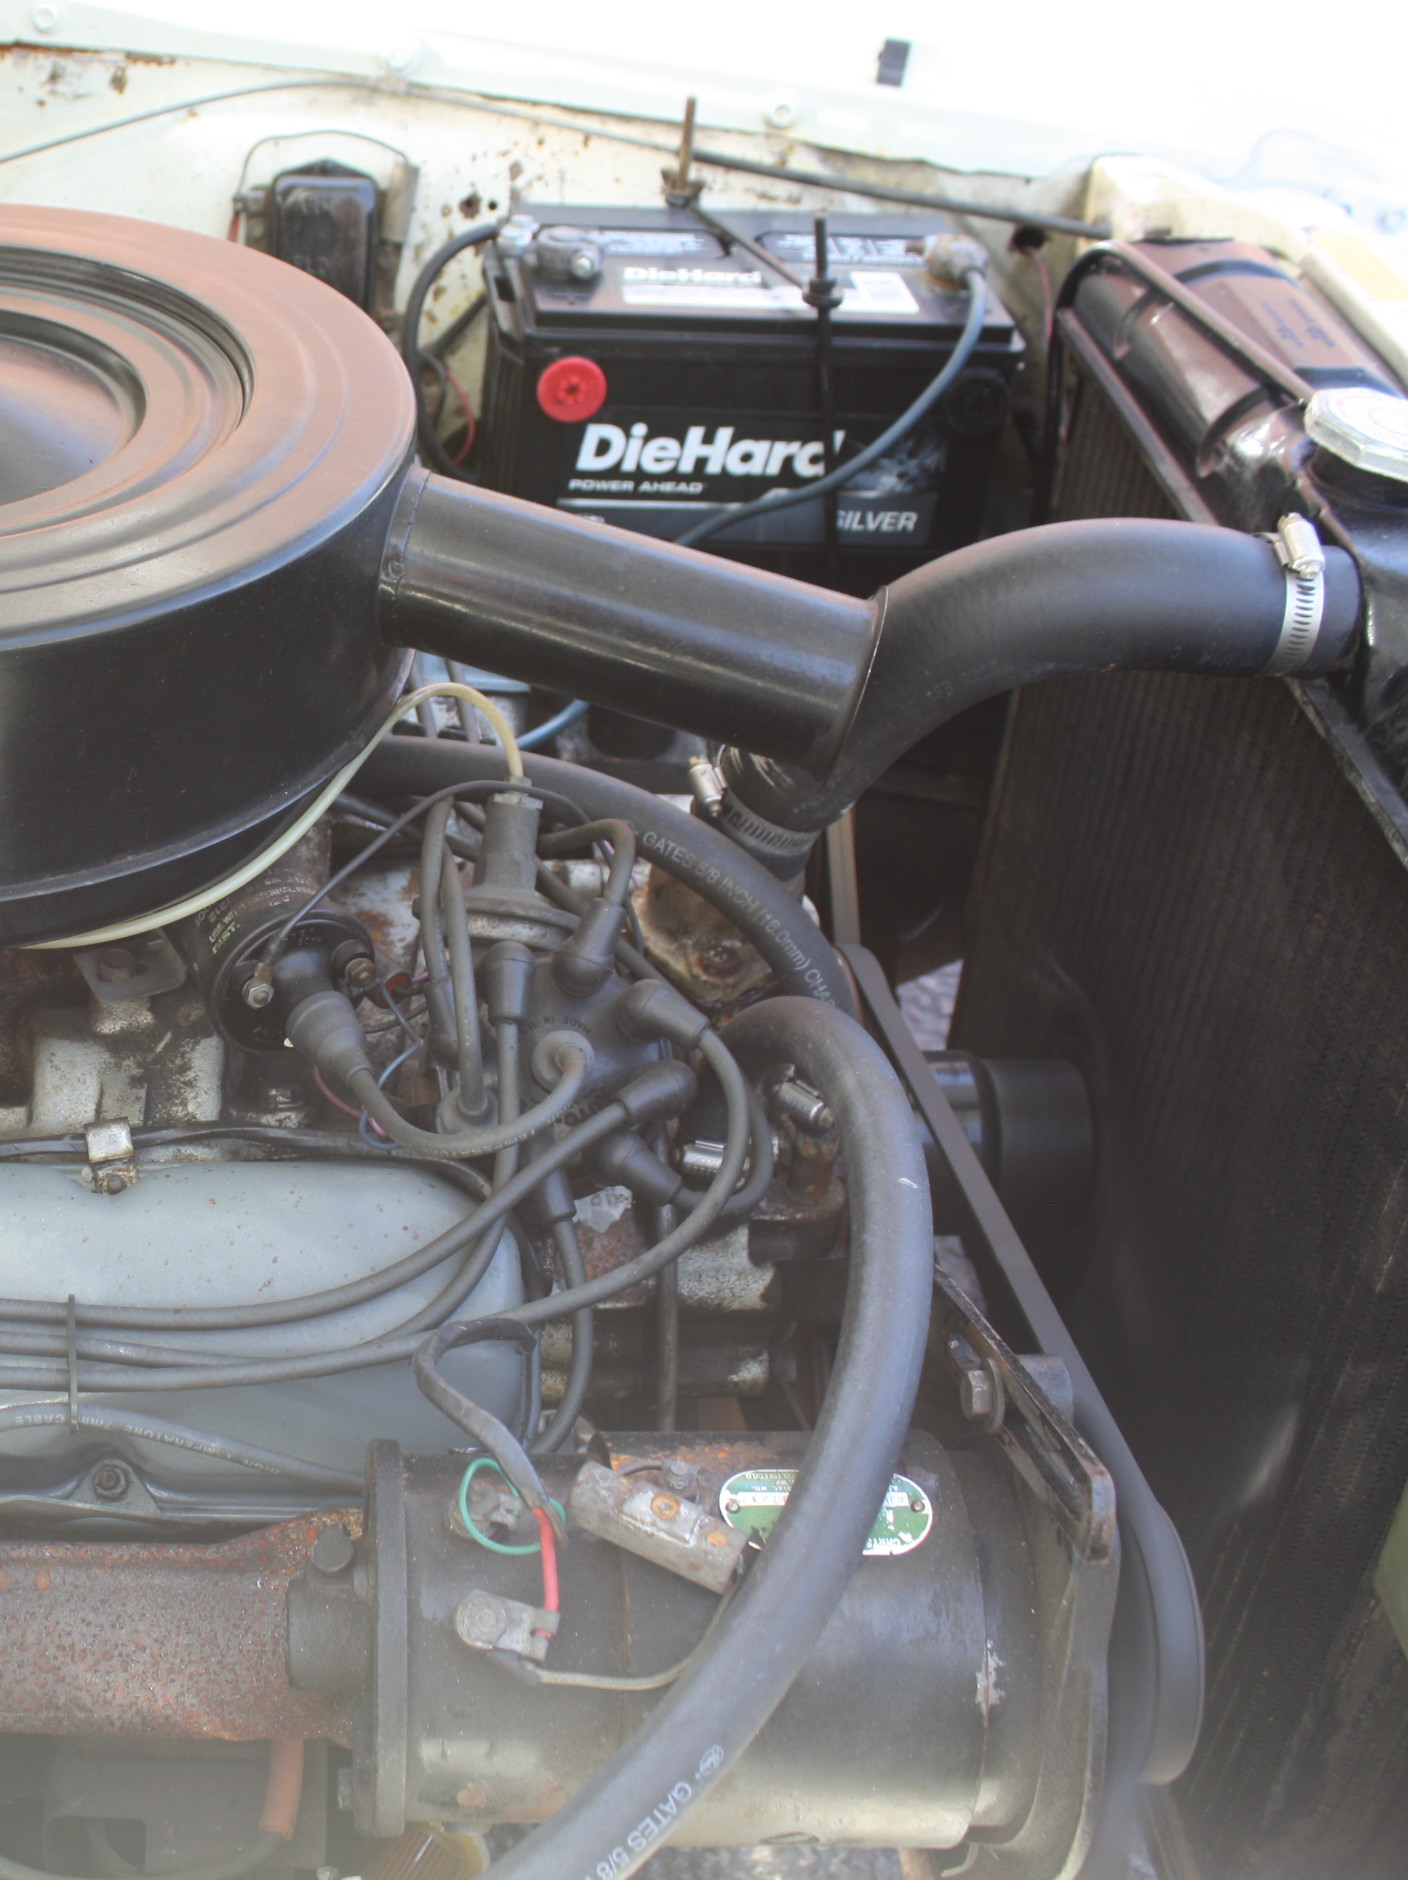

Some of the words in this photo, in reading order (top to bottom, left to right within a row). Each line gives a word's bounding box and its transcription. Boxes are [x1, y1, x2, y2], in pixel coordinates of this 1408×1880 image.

[623, 266, 761, 284] DieHard
[576, 423, 845, 478] DieHard
[568, 479, 634, 493] POWER
[638, 481, 703, 494] AHEAD
[643, 832, 698, 868] GATES
[695, 859, 722, 885] 5/8
[719, 875, 760, 912] INCH
[15, 1413, 65, 1426] CABLE
[866, 1537, 901, 1549] CHRYS
[627, 1780, 692, 1852] GATES
[596, 1846, 630, 1880] 5/8
